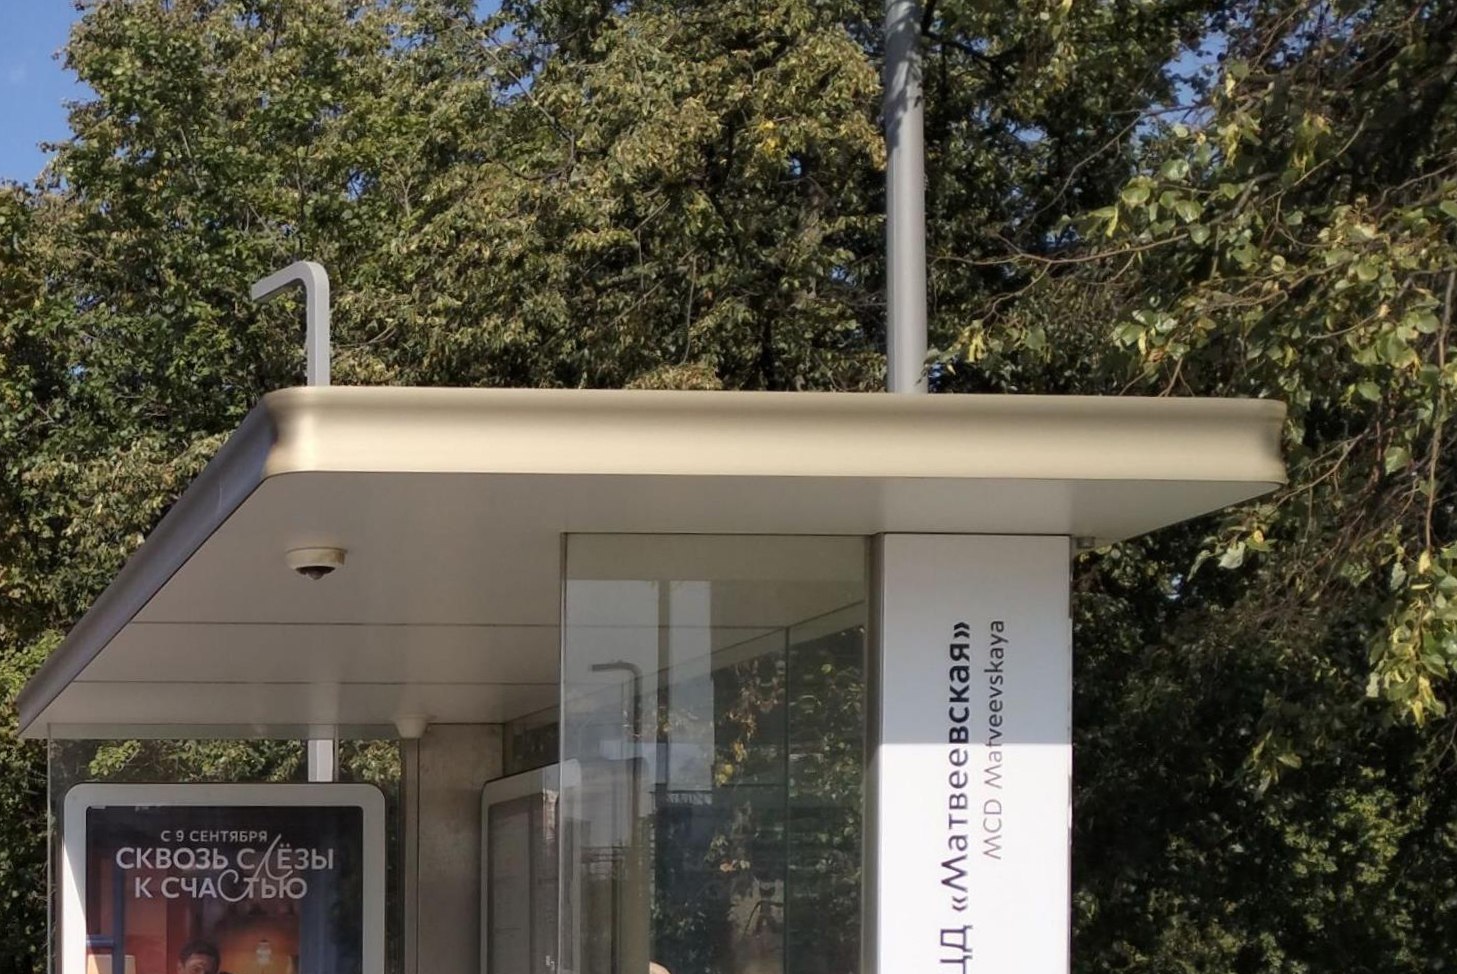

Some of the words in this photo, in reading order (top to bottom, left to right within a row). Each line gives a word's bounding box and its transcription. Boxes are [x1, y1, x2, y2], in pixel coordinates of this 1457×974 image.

[983, 619, 1009, 790] Matveevskaya
[941, 620, 970, 914] «Матвеевская»
[160, 830, 171, 842] С
[176, 830, 185, 842] 9
[189, 830, 268, 842] СЕНТЯБРЯ
[982, 797, 1003, 861] MCD
[116, 847, 229, 870] СКВОЗЬ
[135, 877, 153, 899] К
[160, 869, 308, 902] СЧАСТЬЮ
